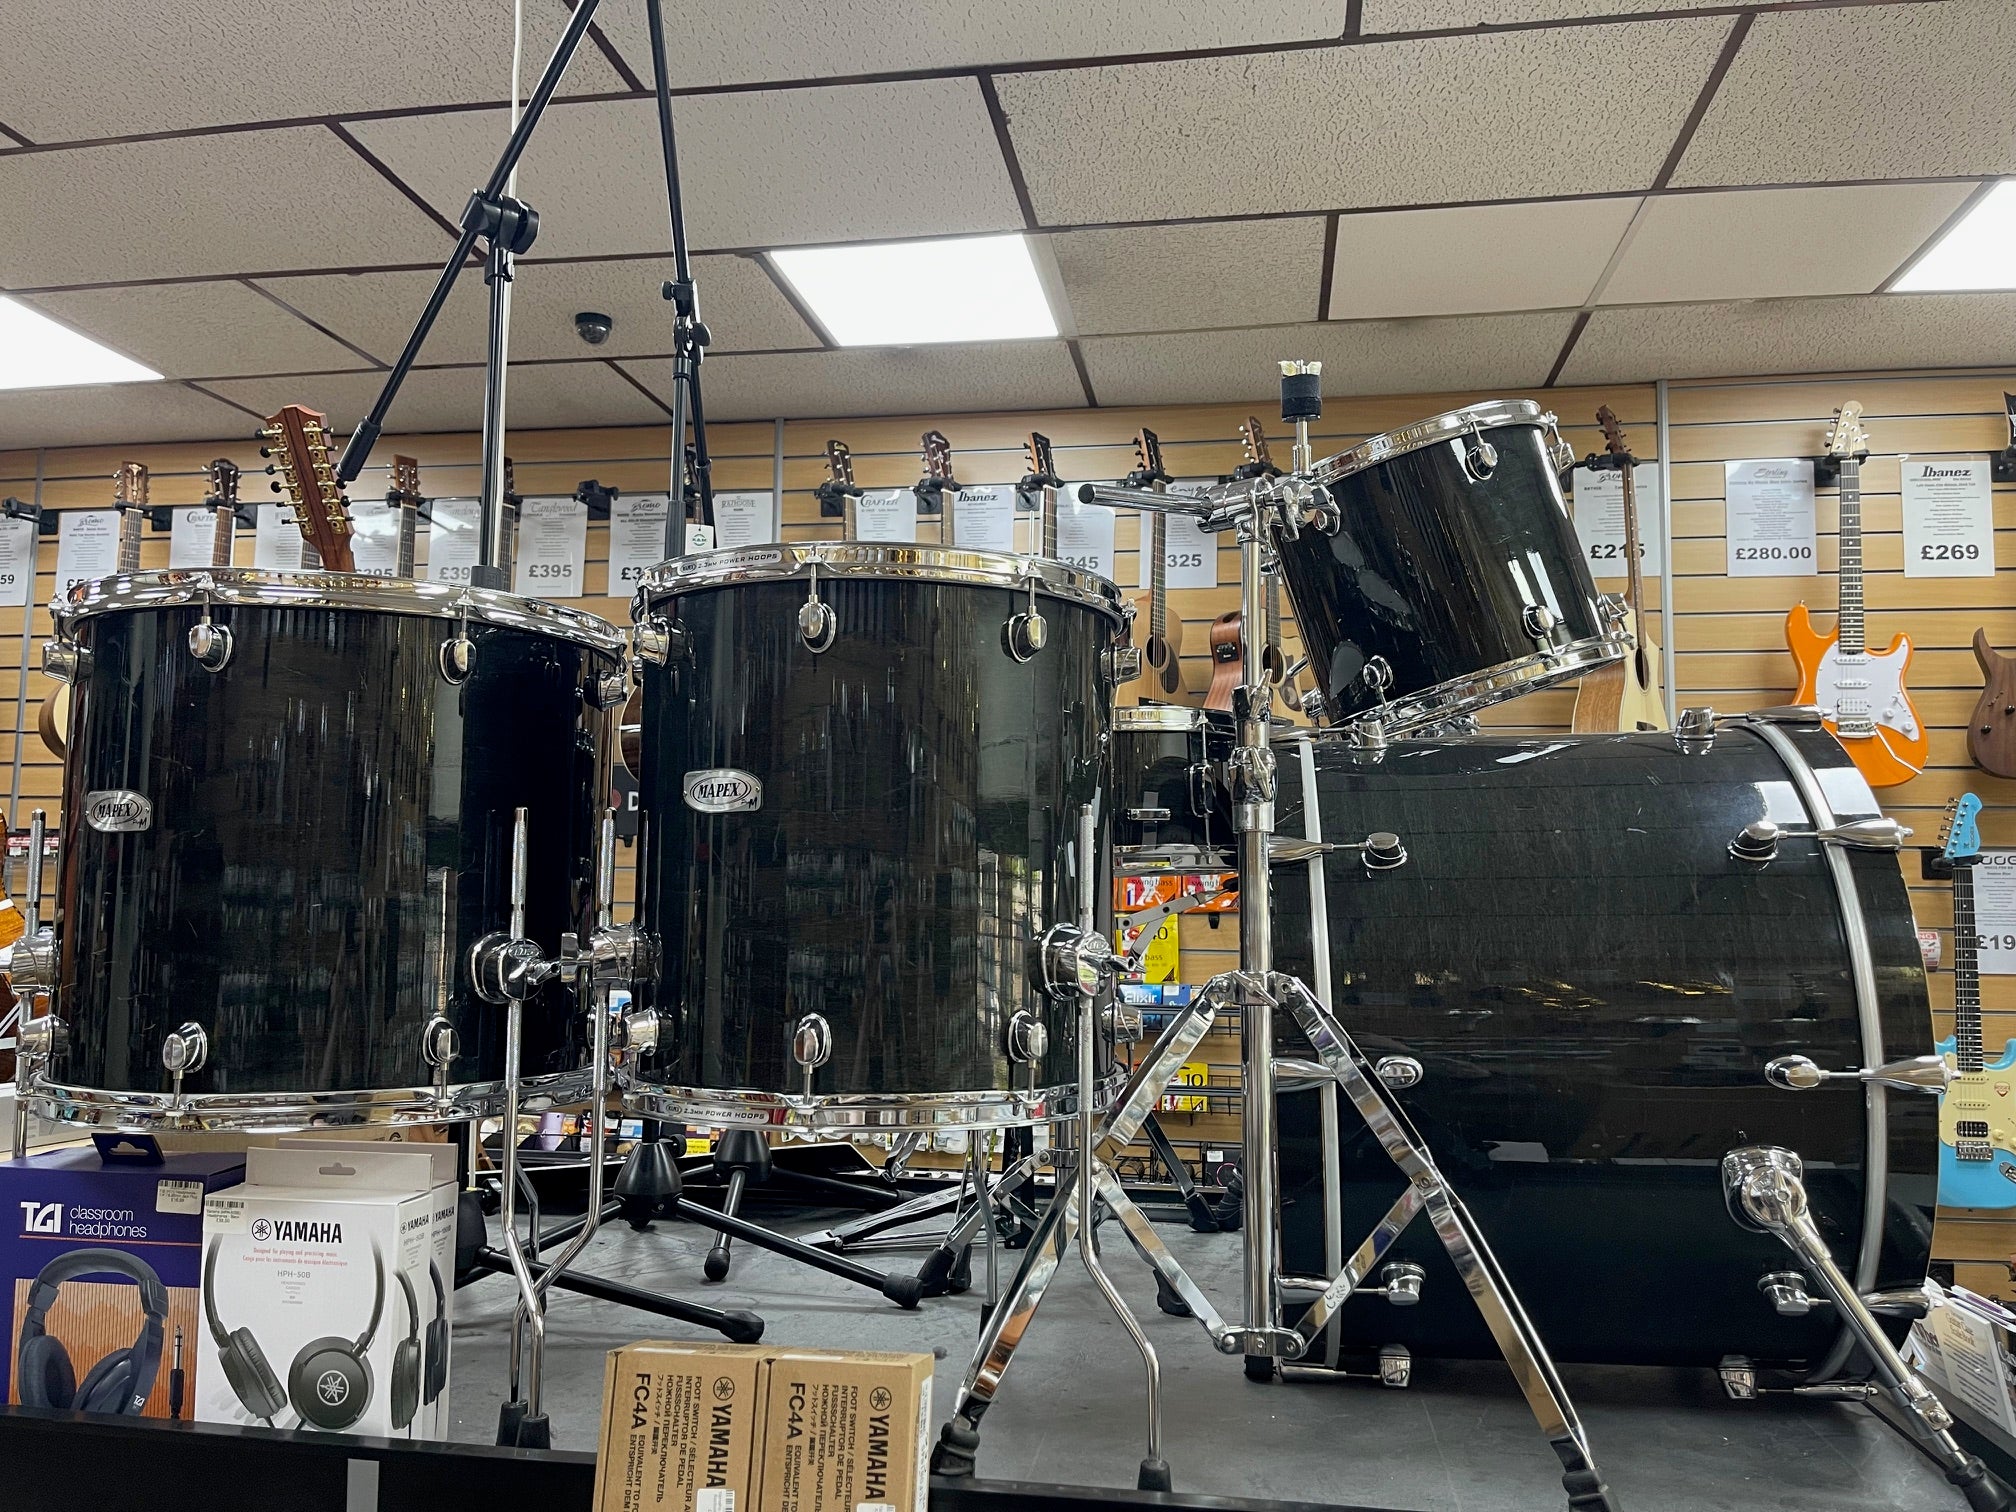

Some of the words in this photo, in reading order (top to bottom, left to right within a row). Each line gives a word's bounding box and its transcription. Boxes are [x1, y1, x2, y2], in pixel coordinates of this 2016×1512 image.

[1921, 465, 1972, 478] Ibanez
[957, 490, 999, 503] Ibanez
[719, 556, 745, 565] POWER
[747, 552, 778, 562] HOOPS
[1167, 553, 1202, 568] 325
[1735, 546, 1812, 561] £280.00
[1920, 544, 1979, 561] £269
[439, 566, 471, 580] £39
[528, 564, 573, 578] £395
[698, 783, 740, 799] MAPEX
[97, 803, 134, 819] MAPEX
[1145, 953, 1163, 961] bass
[1124, 992, 1158, 1004] Elixir
[1185, 1073, 1204, 1087] 10
[735, 1112, 765, 1120] HOOPS
[69, 1204, 134, 1222] classroom
[407, 1213, 430, 1231] YAMAHA
[436, 1206, 455, 1222] YAMAHA
[69, 1220, 147, 1239] headphones
[274, 1220, 343, 1244] YAMAHA
[277, 1269, 311, 1279] HPH-50B
[694, 1376, 702, 1401] FOOT
[631, 1373, 651, 1429] FC4A
[850, 1386, 858, 1410] FOOT
[671, 1375, 683, 1446] FUSSSCHALTER
[681, 1376, 693, 1440] INTERRUPTOR
[787, 1382, 805, 1439] FC4A
[691, 1403, 700, 1439] SWITCH
[828, 1385, 838, 1457] FUSSSCHALTER
[838, 1385, 848, 1451] INTERRUPTOR
[848, 1413, 856, 1449] SWITCH
[679, 1443, 687, 1455] DE
[706, 1404, 732, 1488] YAMAHA
[626, 1434, 637, 1487] ENTSPRICHT
[634, 1435, 645, 1486] EQUIVALENT
[656, 1420, 670, 1503] ПЕРЕКЛЮЧАТЕЛЬ
[837, 1454, 843, 1466] DE
[865, 1414, 890, 1499] YAMAHA
[677, 1458, 686, 1488] PEDAL
[685, 1447, 697, 1502] SÉLECTEUR
[782, 1445, 793, 1498] ENTSPRICHT
[792, 1445, 802, 1497] EQUIVALENT
[835, 1469, 843, 1500] PEDAL
[624, 1490, 632, 1508] DEM
[633, 1489, 641, 1501] TO
